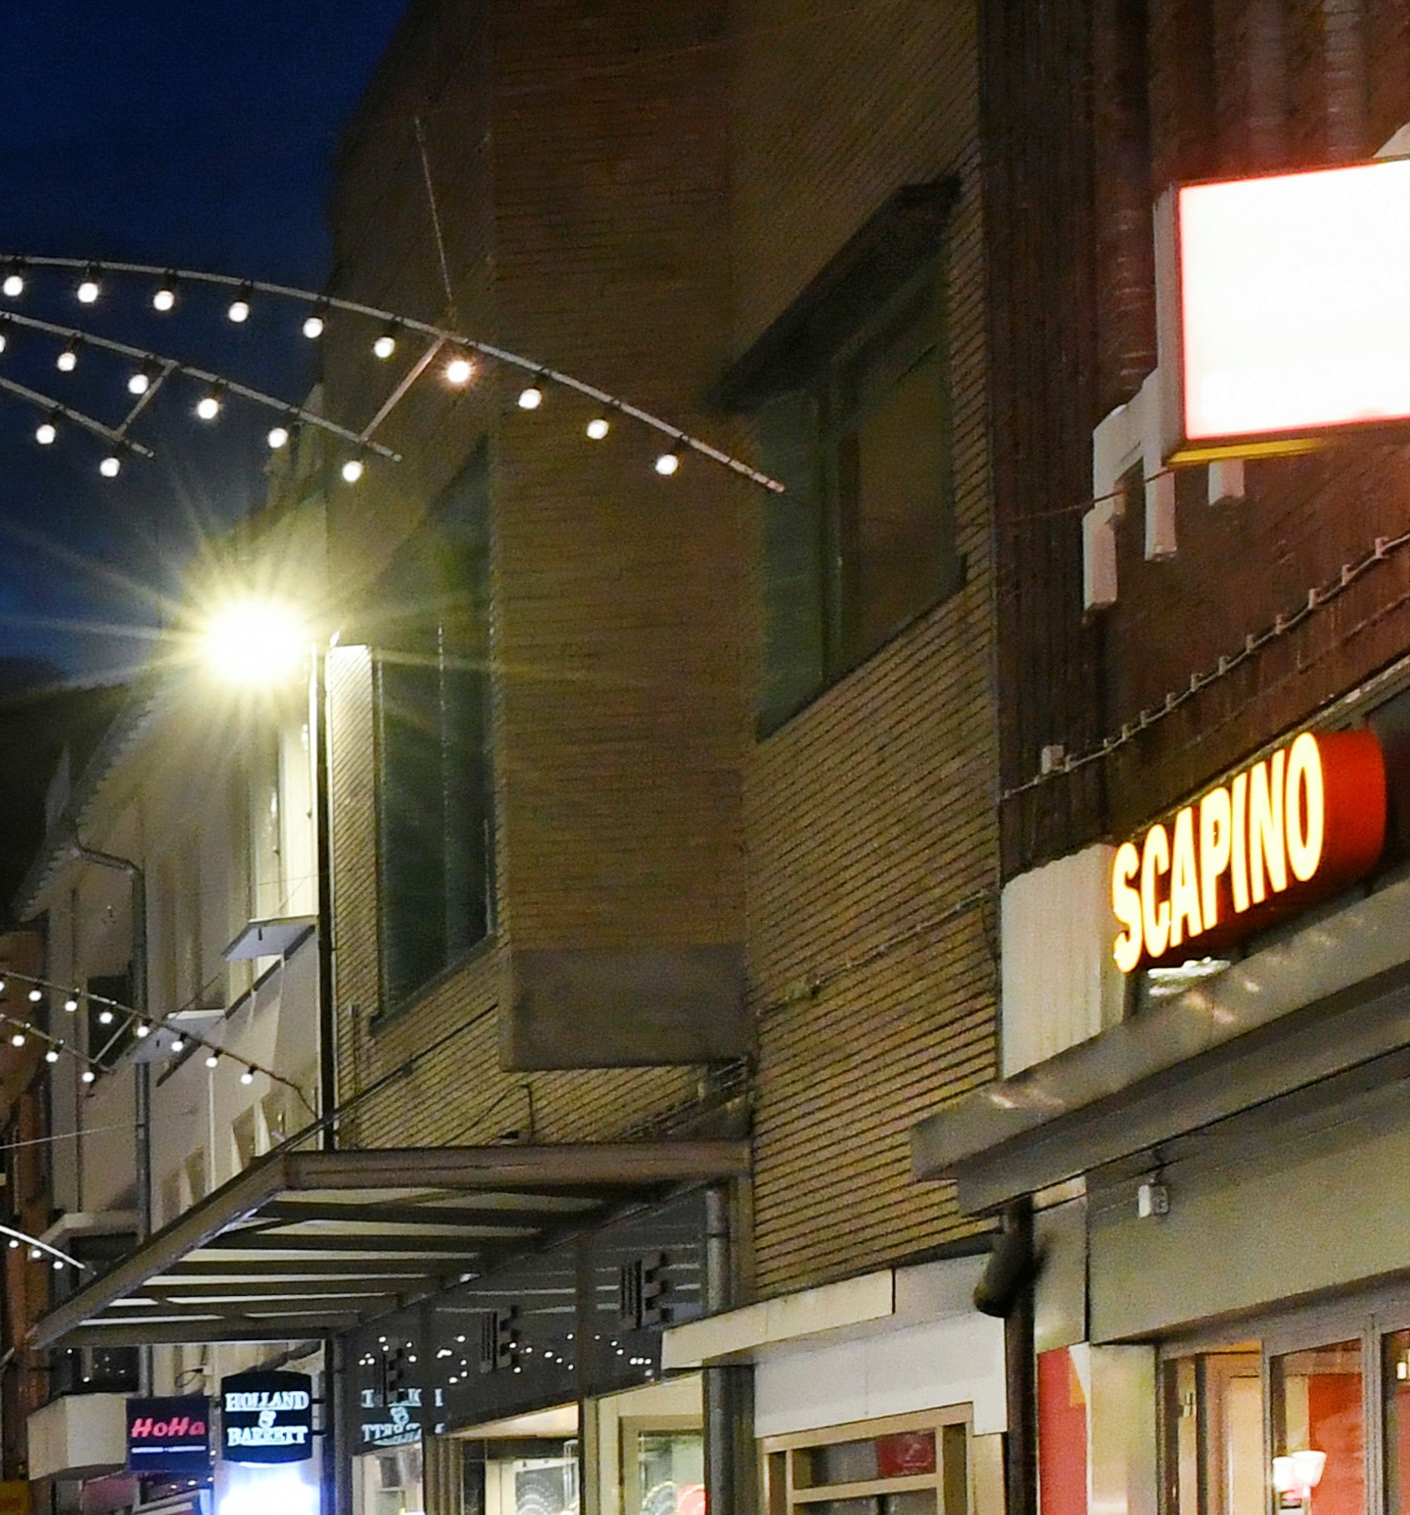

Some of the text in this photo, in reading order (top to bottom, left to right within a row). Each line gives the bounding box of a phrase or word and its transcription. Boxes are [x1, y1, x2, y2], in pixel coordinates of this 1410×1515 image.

[1112, 732, 1324, 973] SCAPINO
[224, 1391, 310, 1413] HOLLAND
[131, 1416, 206, 1438] HoHa
[258, 1410, 277, 1429] &
[226, 1426, 309, 1447] BARRETT
